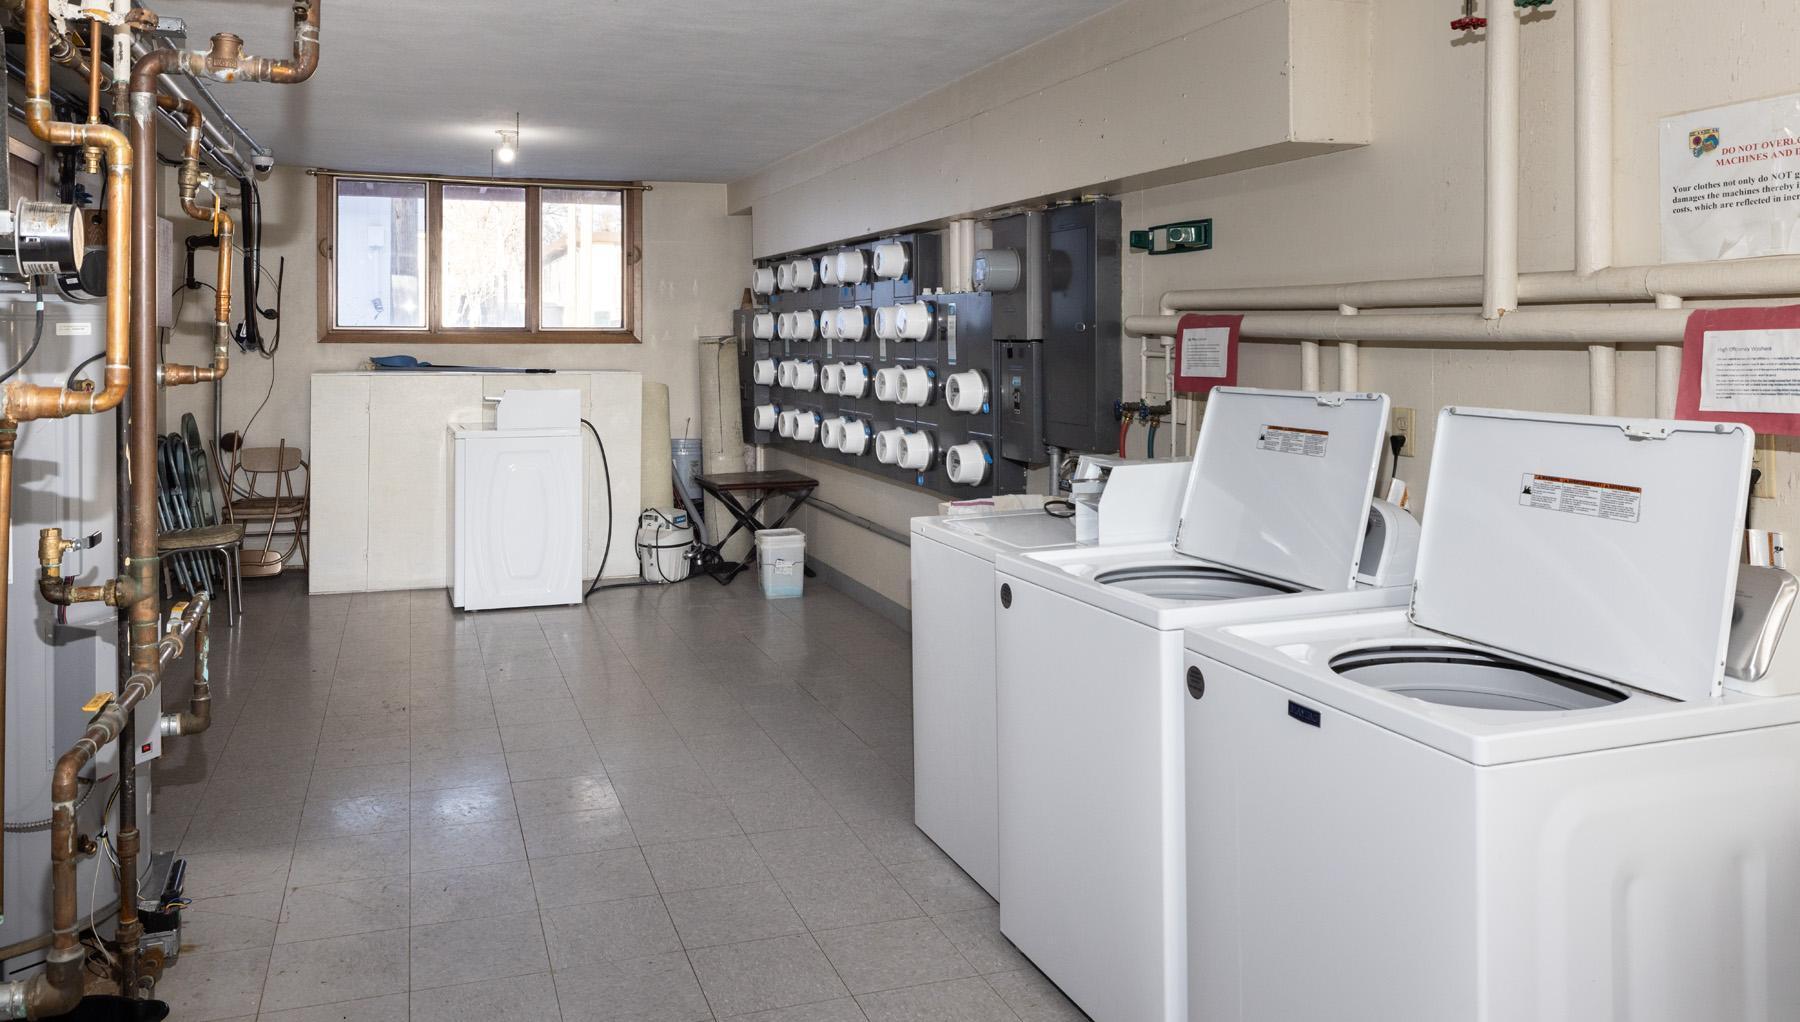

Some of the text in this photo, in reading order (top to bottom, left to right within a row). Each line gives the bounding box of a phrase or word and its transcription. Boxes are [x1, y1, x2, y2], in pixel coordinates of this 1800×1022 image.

[1716, 152, 1768, 166] MACHINES
[1772, 149, 1792, 158] AND
[1722, 147, 1736, 155] DO
[1739, 143, 1757, 151] NOT
[1693, 182, 1720, 191] clothes
[1738, 176, 1754, 185] only
[1772, 171, 1792, 179] NOT
[1672, 195, 1704, 203] damages
[1722, 188, 1759, 197] machines
[1762, 183, 1794, 193] thereby
[1695, 202, 1717, 210] which
[1736, 196, 1770, 206] reflected
